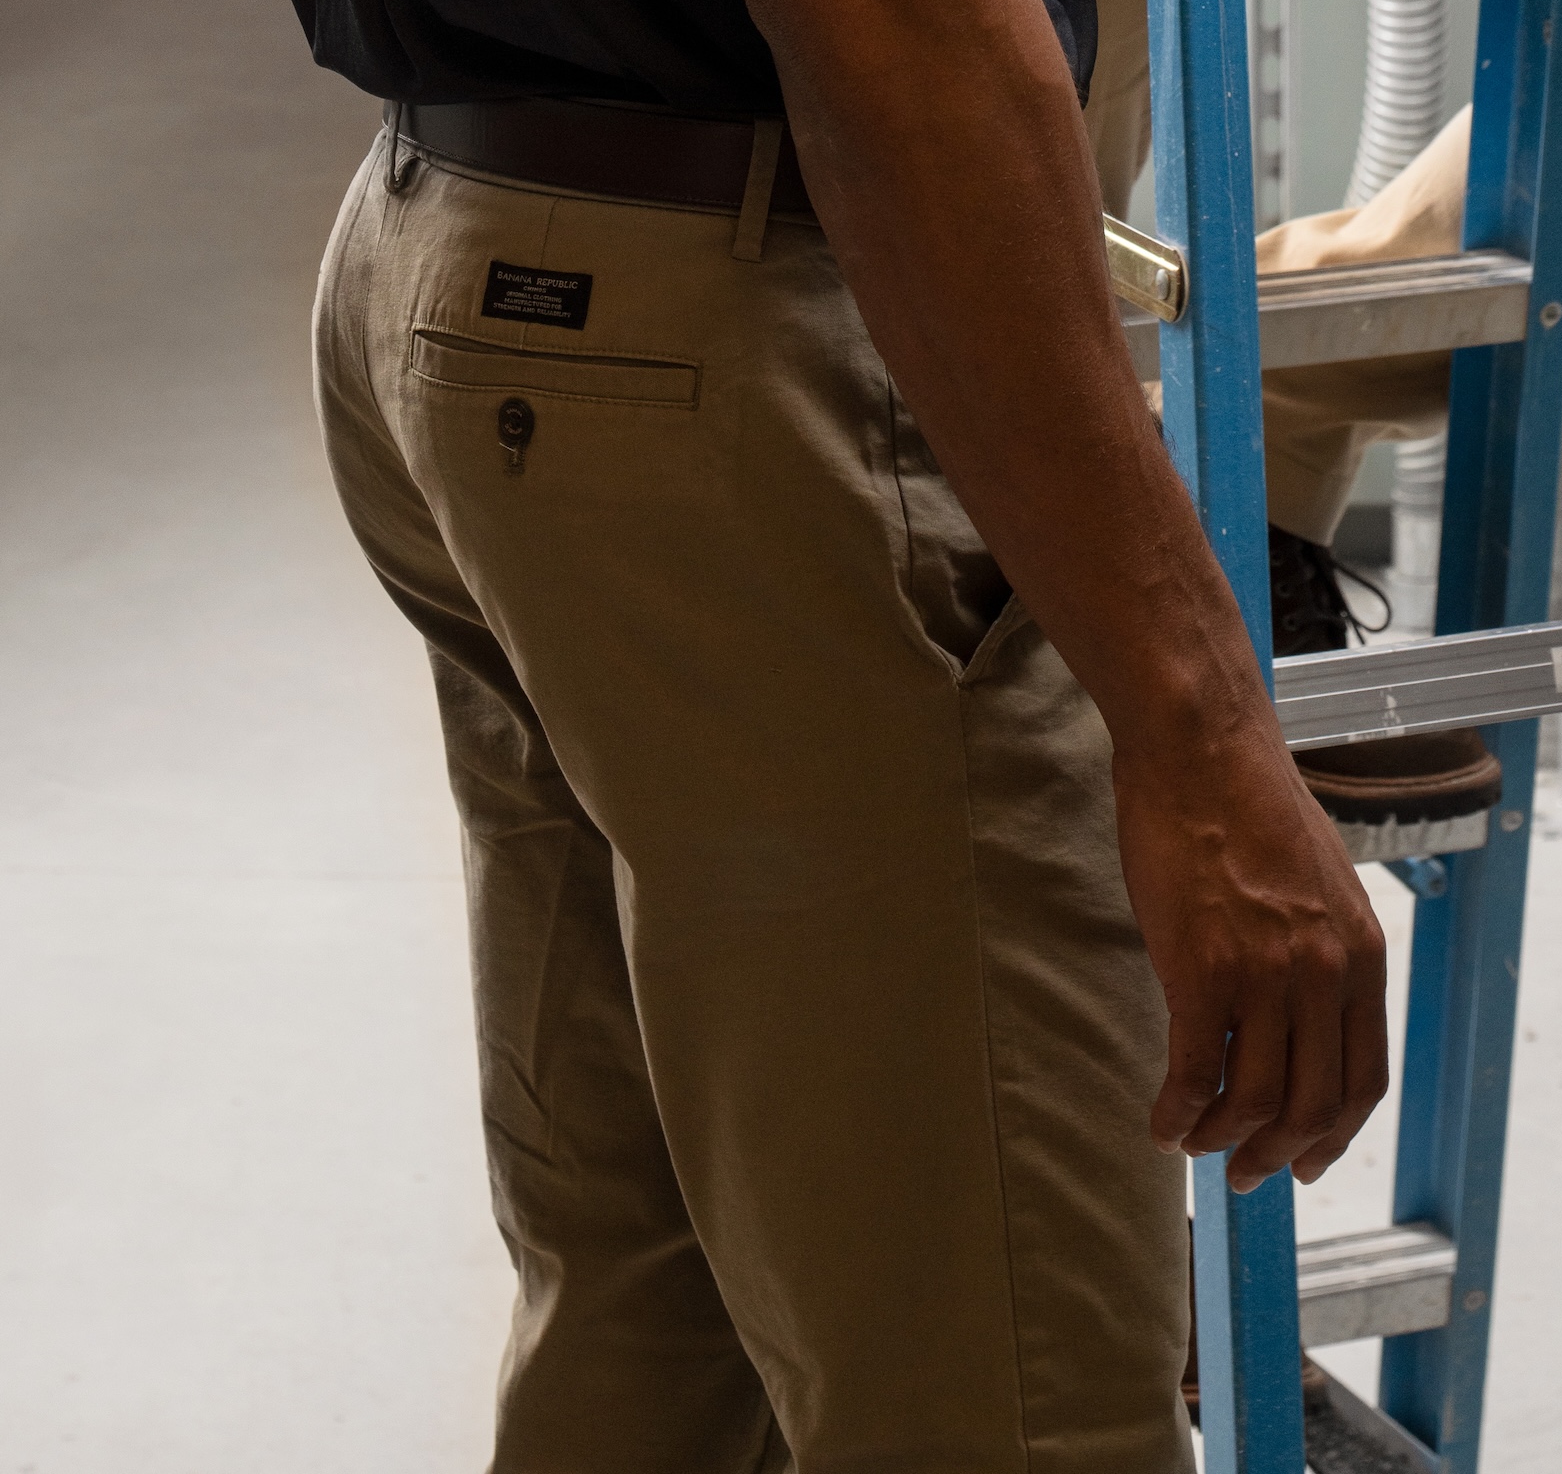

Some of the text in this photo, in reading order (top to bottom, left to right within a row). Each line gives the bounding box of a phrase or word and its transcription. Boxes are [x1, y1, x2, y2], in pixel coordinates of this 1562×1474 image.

[497, 271, 579, 289] BANANA REPUBLIC
[533, 295, 562, 303] CLOTHING
